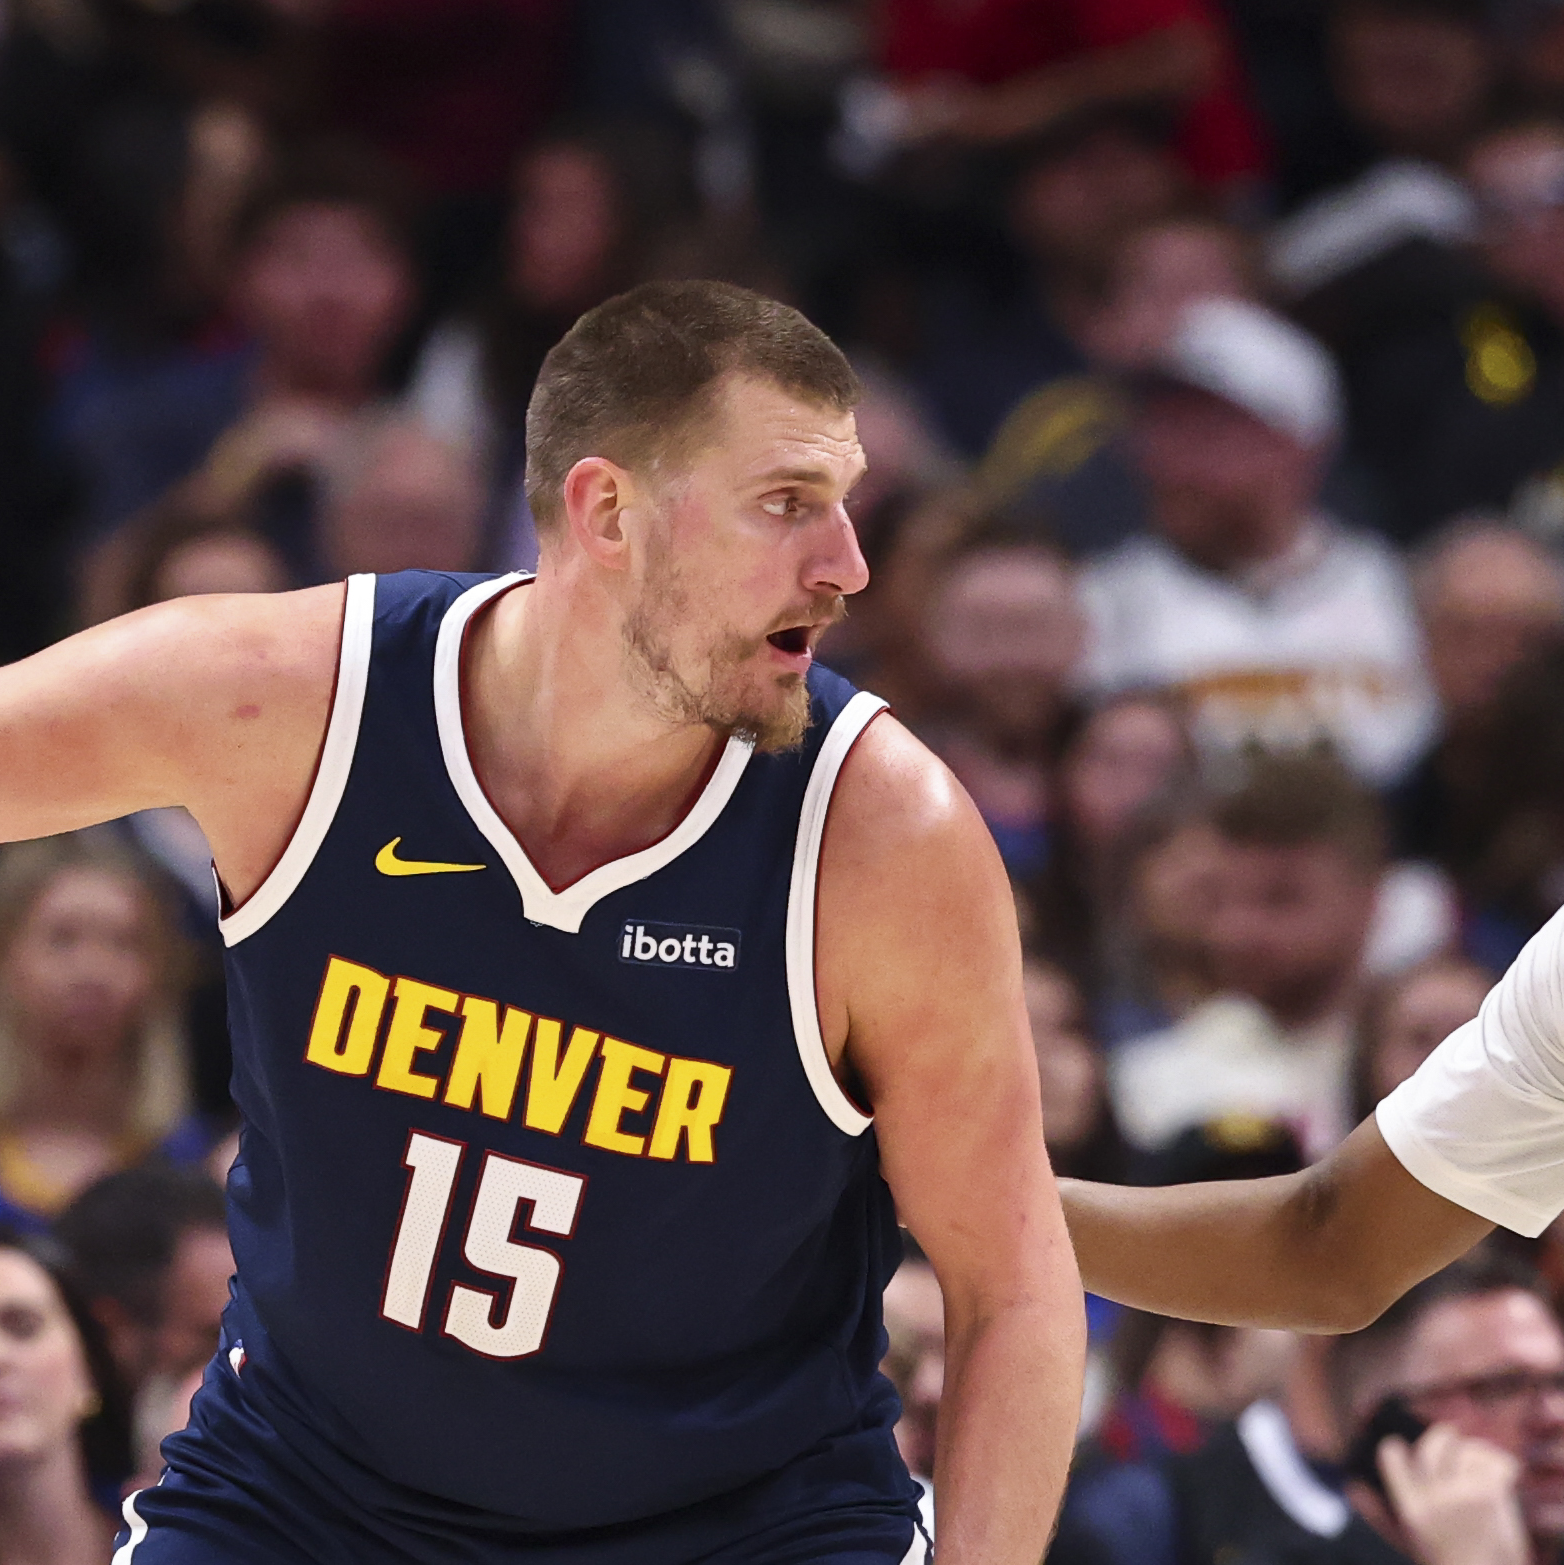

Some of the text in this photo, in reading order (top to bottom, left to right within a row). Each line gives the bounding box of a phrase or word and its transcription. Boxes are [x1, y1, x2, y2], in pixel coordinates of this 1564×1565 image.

[622, 925, 735, 967] ibotta
[302, 953, 734, 1163] DENVER
[378, 1127, 590, 1362] 15
